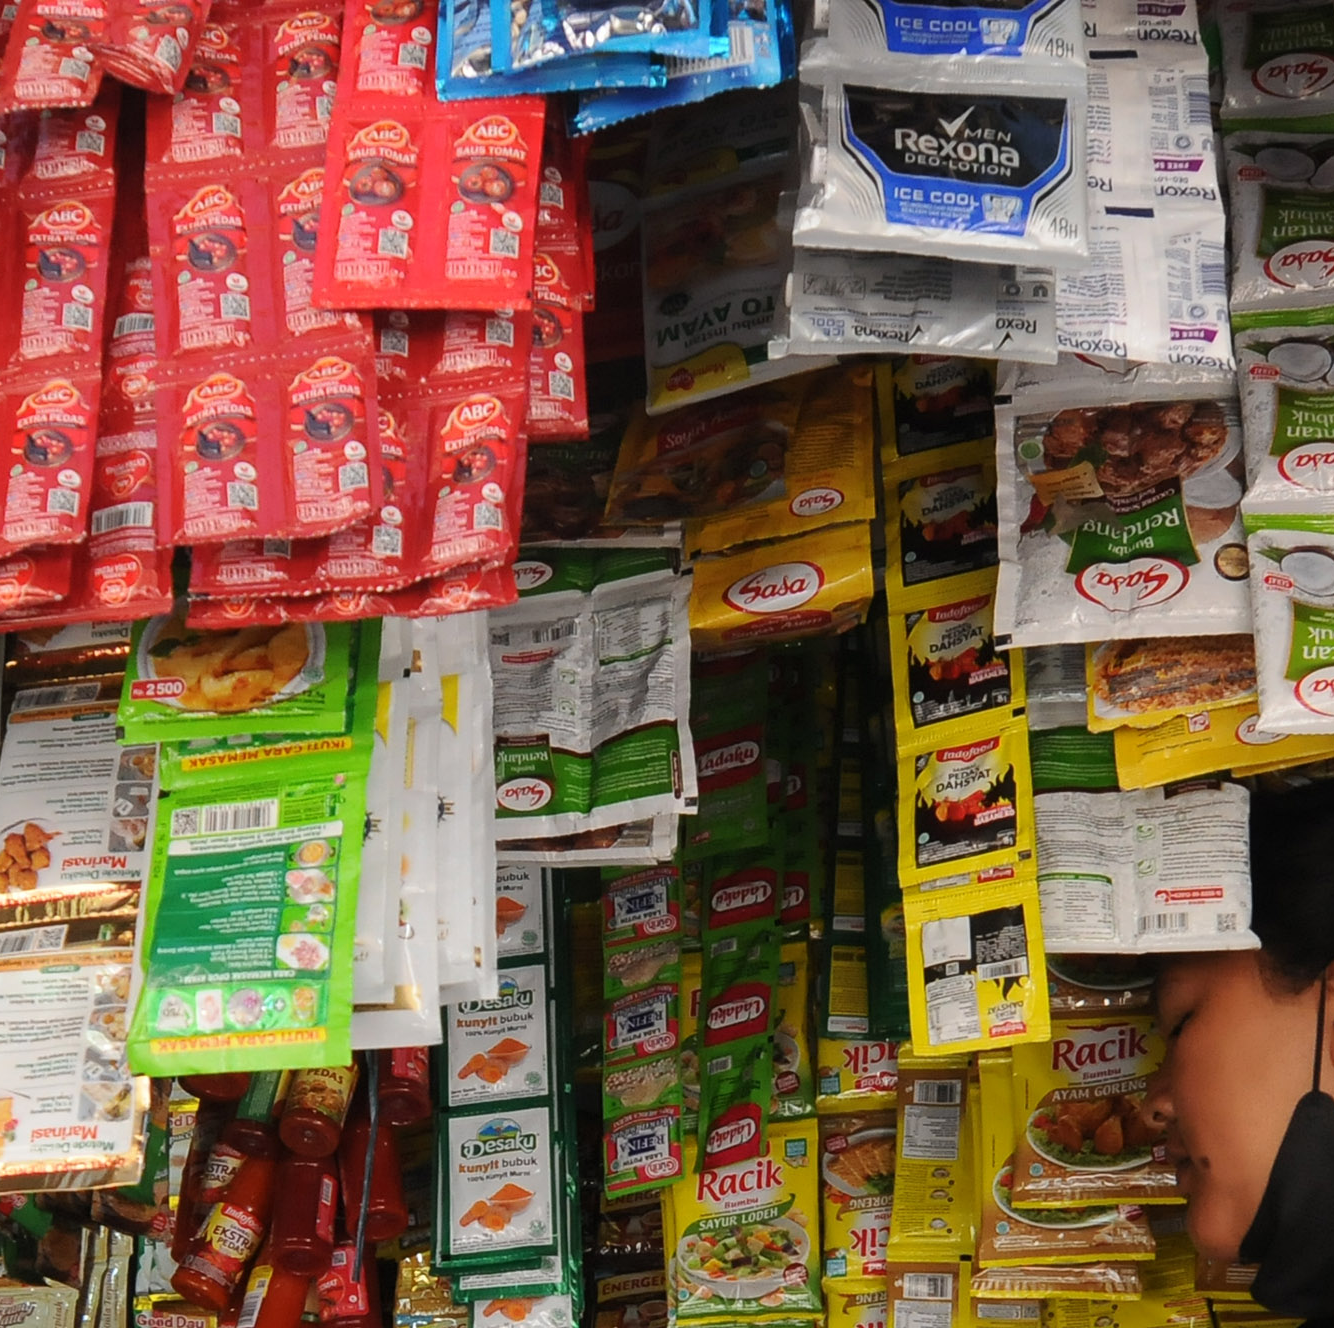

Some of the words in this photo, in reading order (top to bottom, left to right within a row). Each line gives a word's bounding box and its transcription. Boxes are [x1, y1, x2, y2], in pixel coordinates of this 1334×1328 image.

[288, 14, 325, 29] ABC
[894, 17, 922, 32] ICE
[928, 17, 978, 33] COOL
[1045, 36, 1075, 59] 48H
[365, 126, 403, 143] ABC
[474, 123, 512, 141] ABC
[963, 128, 1012, 142] MEN
[348, 147, 376, 160] SAUS
[377, 150, 417, 164] TOMAT
[455, 145, 486, 158] SAUS
[487, 146, 528, 159] TOMAT
[895, 128, 1020, 168] Rexona
[904, 152, 1012, 178] DEO-LOTION
[192, 190, 228, 209] ABC
[893, 186, 925, 202] ICE
[929, 189, 979, 207] COOL
[47, 208, 84, 223] ABC
[1047, 214, 1079, 240] 48H
[29, 234, 61, 243] EXTRA
[63, 233, 97, 243] PEDAS
[657, 299, 731, 347] AYAM
[1058, 335, 1128, 357] Rexona
[306, 364, 344, 378] ABC
[37, 389, 73, 404] ABC
[199, 382, 235, 396] ABC
[291, 388, 324, 401] EXTRA
[325, 384, 361, 396] PEDAS
[186, 413, 218, 425] EXTRA
[219, 406, 253, 418] PEDAS
[457, 402, 495, 423] ABC
[17, 417, 48, 429] EXTRA
[50, 414, 85, 425] PEDAS
[1082, 506, 1181, 545] Rendang
[1107, 535, 1155, 557] Bumbu
[739, 569, 807, 605] Sasa
[1092, 563, 1169, 601] Sasa
[929, 627, 985, 654] DAHSYAT
[146, 683, 182, 695] 2500
[274, 743, 308, 756] CARA
[309, 739, 346, 750] IKUTI
[943, 740, 996, 760] Indofood
[188, 747, 271, 768] MEMASAK
[935, 768, 991, 793] DAHSYAT
[503, 782, 547, 808] Sasa
[61, 854, 127, 868] Marinasi
[60, 870, 100, 881] Desaku
[103, 869, 141, 879] Metode
[497, 873, 530, 882] bubuk
[457, 1015, 498, 1028] kunyit
[500, 1012, 534, 1023] bubuk
[157, 1034, 243, 1053] MEMASAK
[245, 1032, 279, 1045] CARA
[283, 1030, 321, 1042] IKUTI
[1052, 1031, 1149, 1072] Racik
[305, 1068, 345, 1084] PEDAS
[1082, 1067, 1122, 1081] Bumbu
[1051, 1085, 1091, 1102] AYAM
[1094, 1078, 1147, 1098] GORENG
[31, 1125, 98, 1139] Marinasi
[72, 1141, 115, 1152] Metode
[463, 1132, 536, 1157] Desaku
[459, 1160, 500, 1173] kunyit
[502, 1158, 538, 1167] bubuk
[697, 1161, 784, 1202] Racik
[724, 1196, 759, 1208] Bumbu
[699, 1215, 739, 1231] SAYUR
[741, 1206, 779, 1224] LODEH
[216, 1235, 246, 1256] PEDAS
[135, 1314, 170, 1328] Good
